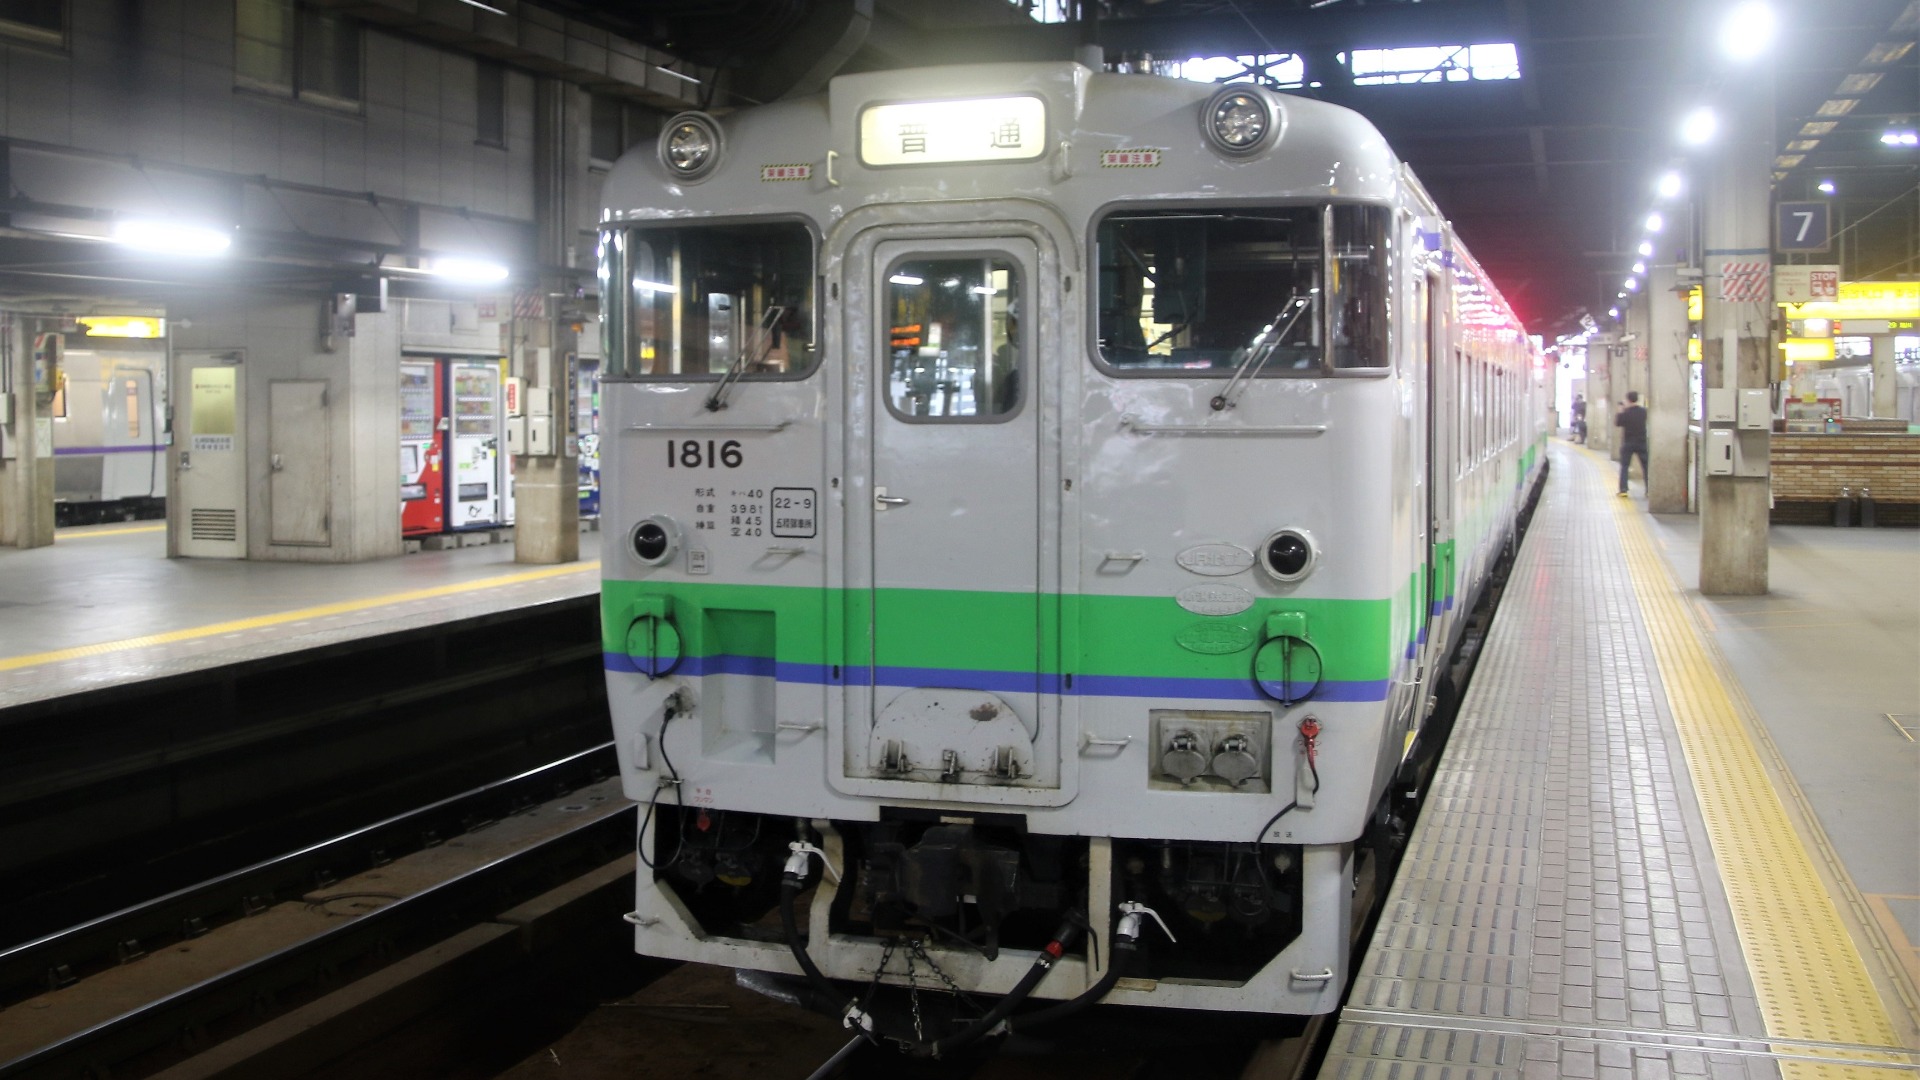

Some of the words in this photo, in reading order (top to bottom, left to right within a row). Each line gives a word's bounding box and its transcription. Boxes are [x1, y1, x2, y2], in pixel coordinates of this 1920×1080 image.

[898, 117, 1022, 154] 普通
[1793, 211, 1813, 241] 7
[668, 440, 743, 468] 1816
[695, 488, 715, 497] 形式
